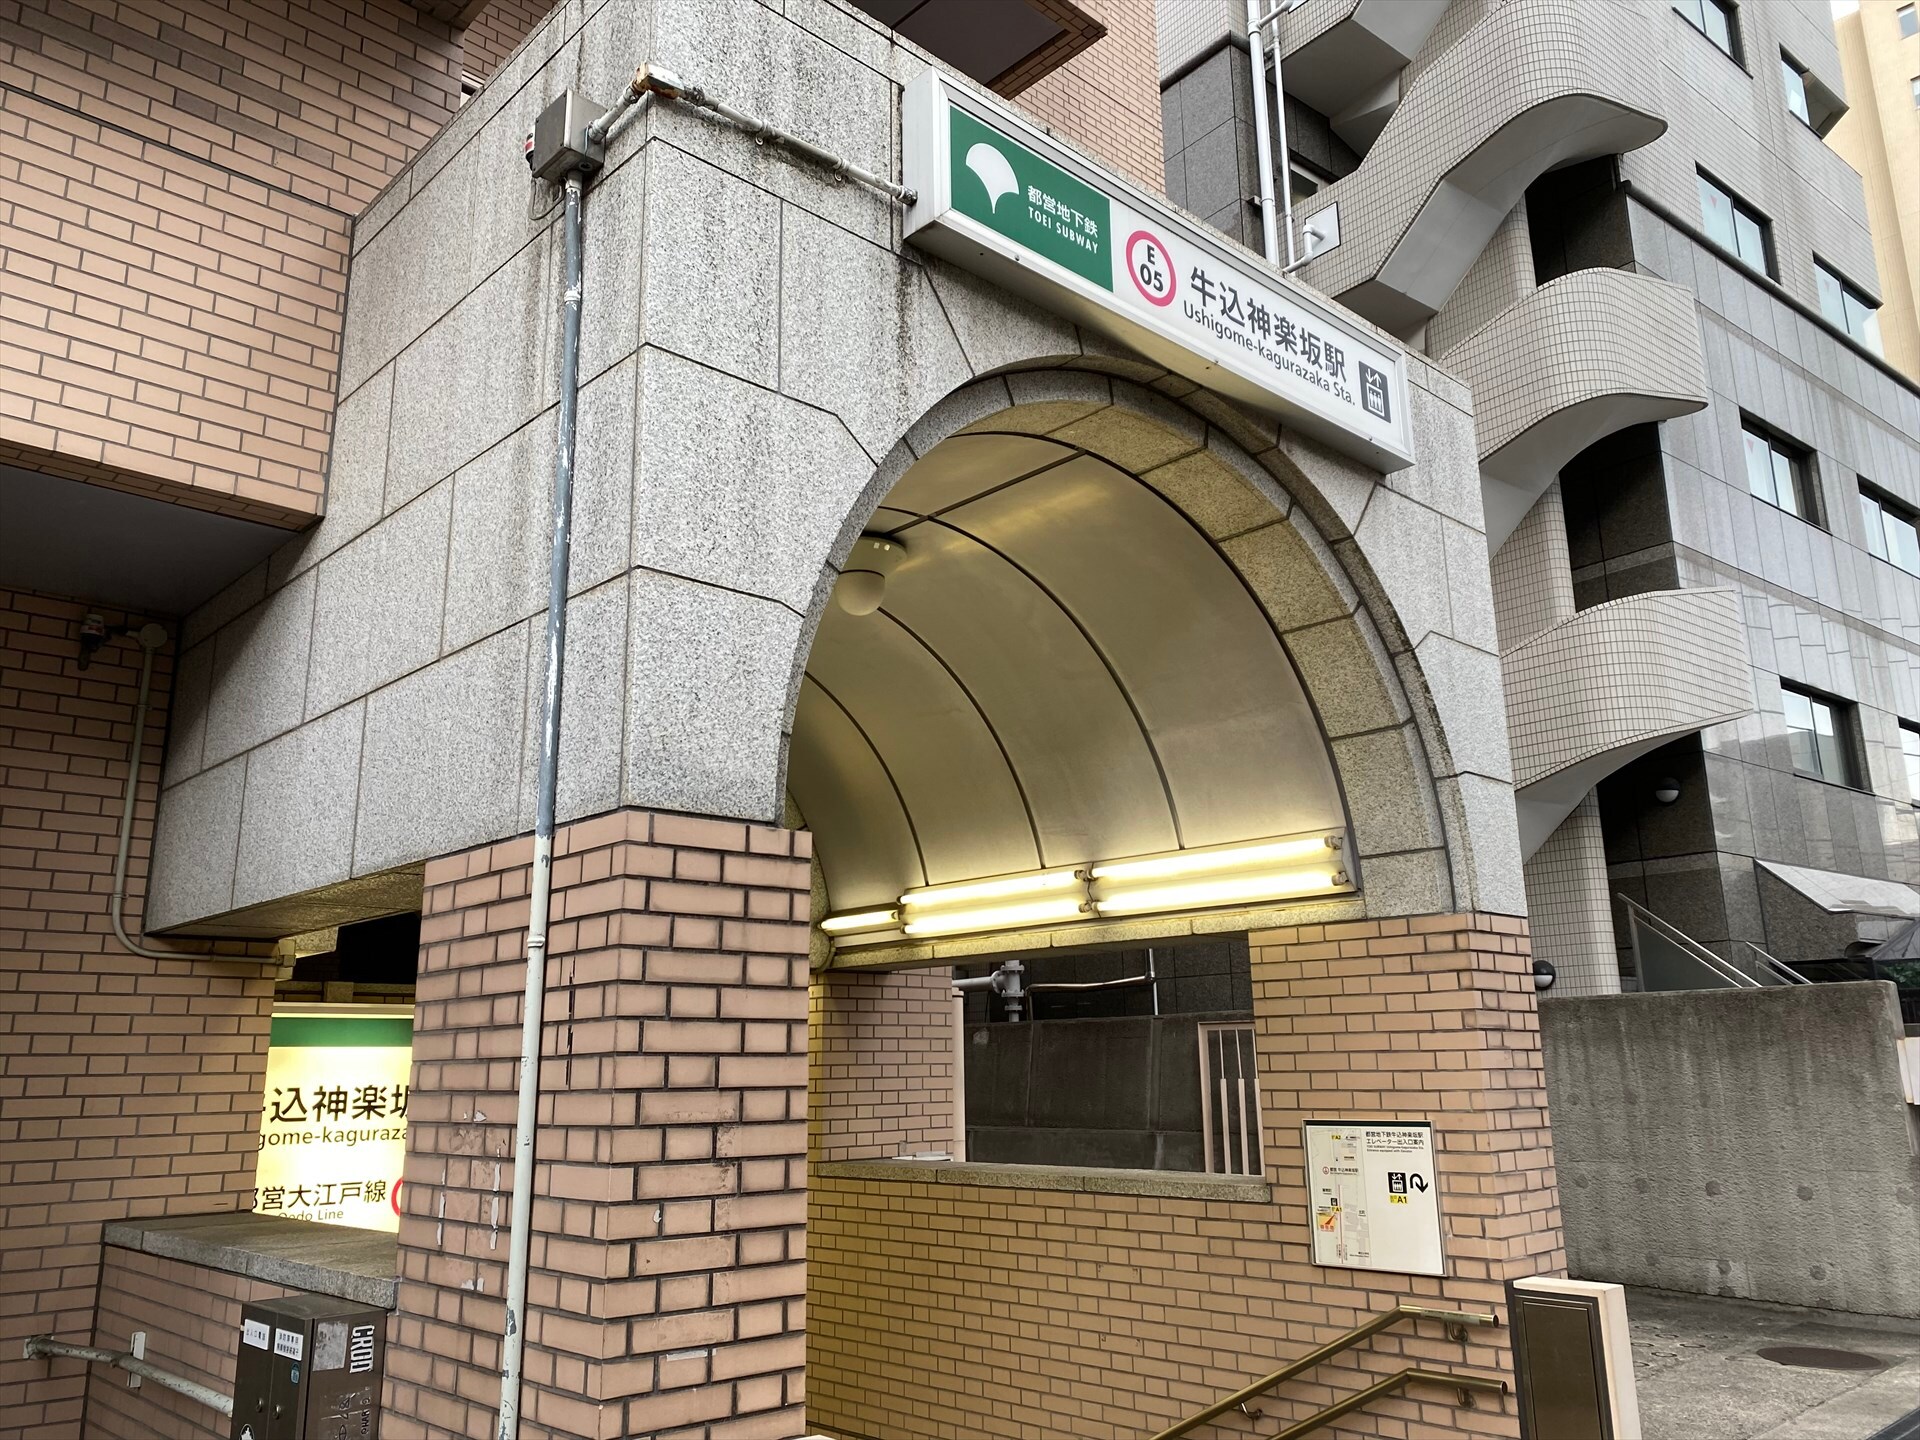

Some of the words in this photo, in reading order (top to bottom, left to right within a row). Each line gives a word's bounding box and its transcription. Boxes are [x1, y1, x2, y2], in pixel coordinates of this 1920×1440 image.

[1027, 185, 1098, 238] 都営地下鉄
[1028, 206, 1052, 229] TOEI
[1056, 222, 1099, 254] SUBWAY
[1147, 244, 1156, 266] E
[1139, 263, 1164, 293] 05
[1190, 265, 1347, 383] 牛込神楽坂駅
[1183, 299, 1331, 393] Ushigome-kagurazaka
[1333, 384, 1356, 406] Sta.
[262, 1084, 409, 1123] 込神楽坂
[318, 1208, 344, 1221] Line
[1397, 1195, 1408, 1204] A1
